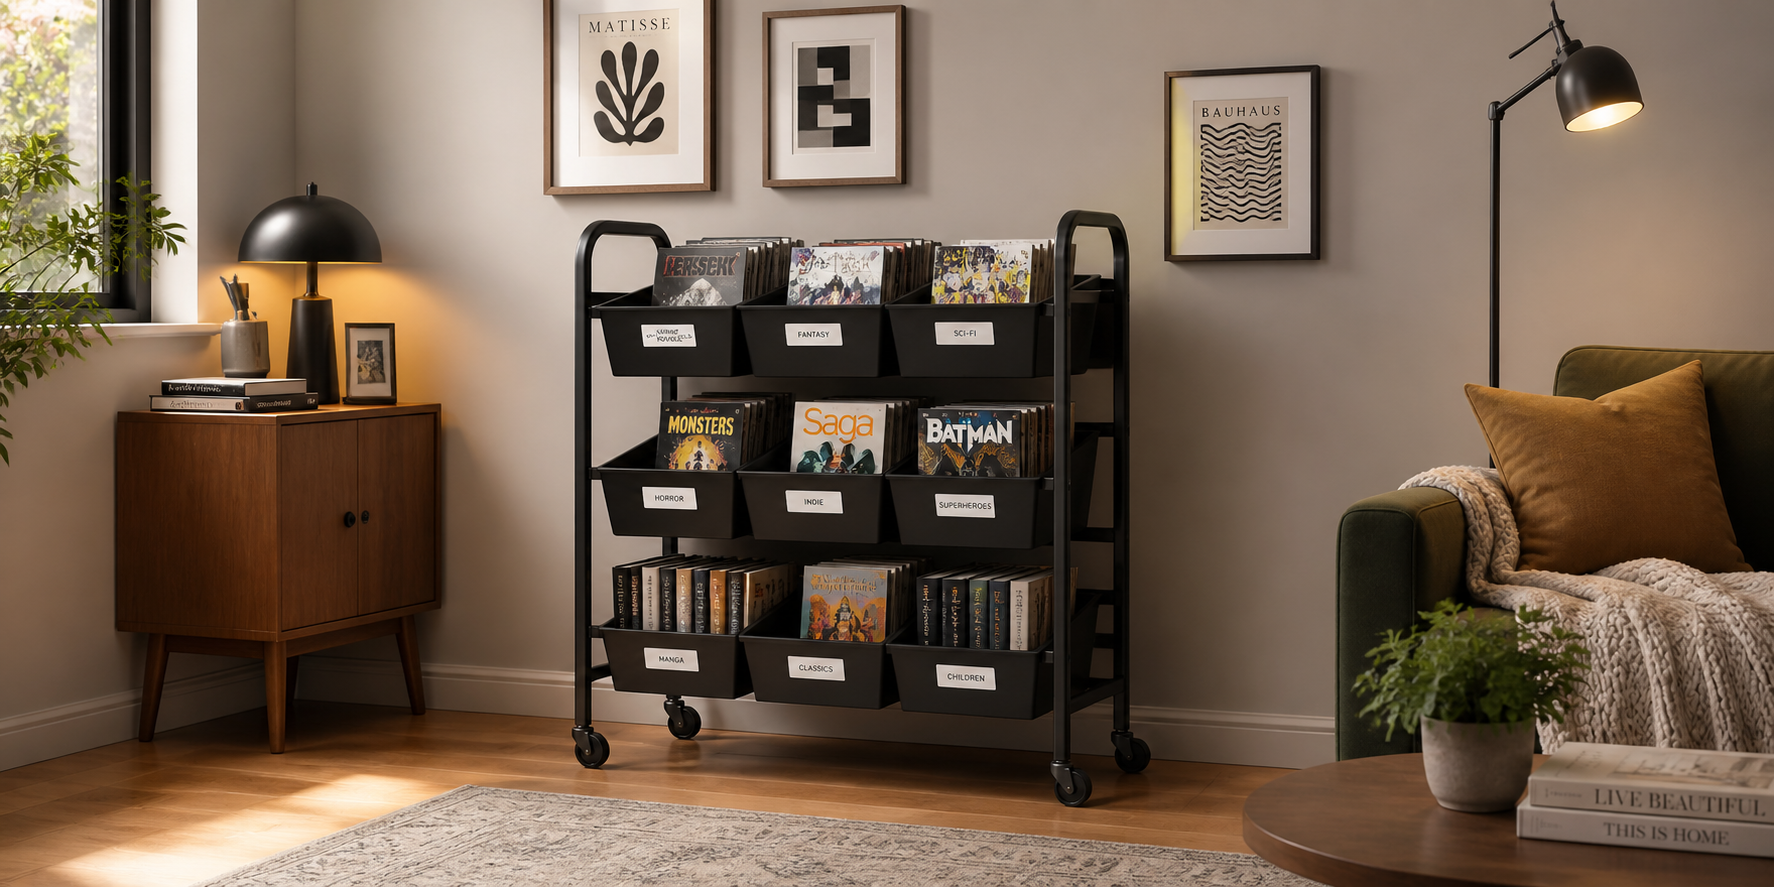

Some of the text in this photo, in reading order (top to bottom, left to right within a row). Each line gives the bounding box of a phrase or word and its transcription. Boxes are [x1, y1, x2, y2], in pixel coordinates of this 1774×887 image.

[588, 17, 671, 34] MATISSE
[1201, 105, 1281, 118] BAUHAUS
[797, 331, 830, 339] FANTASY
[953, 329, 977, 337] SCI-FI
[667, 415, 734, 436] MONSTERS
[803, 407, 874, 444] Saga
[926, 417, 1013, 452] BATMAN
[654, 494, 684, 503] HORROR
[803, 498, 824, 506] INDIE
[938, 501, 992, 510] SUPERHEROES
[658, 655, 684, 664] MANGA
[798, 664, 833, 673] CLASSICS
[947, 673, 985, 682] CHILDREN
[1594, 788, 1642, 808] LIVE
[1649, 792, 1766, 817] BEAUTIFUL
[1603, 821, 1730, 846] THIS IS HOME
